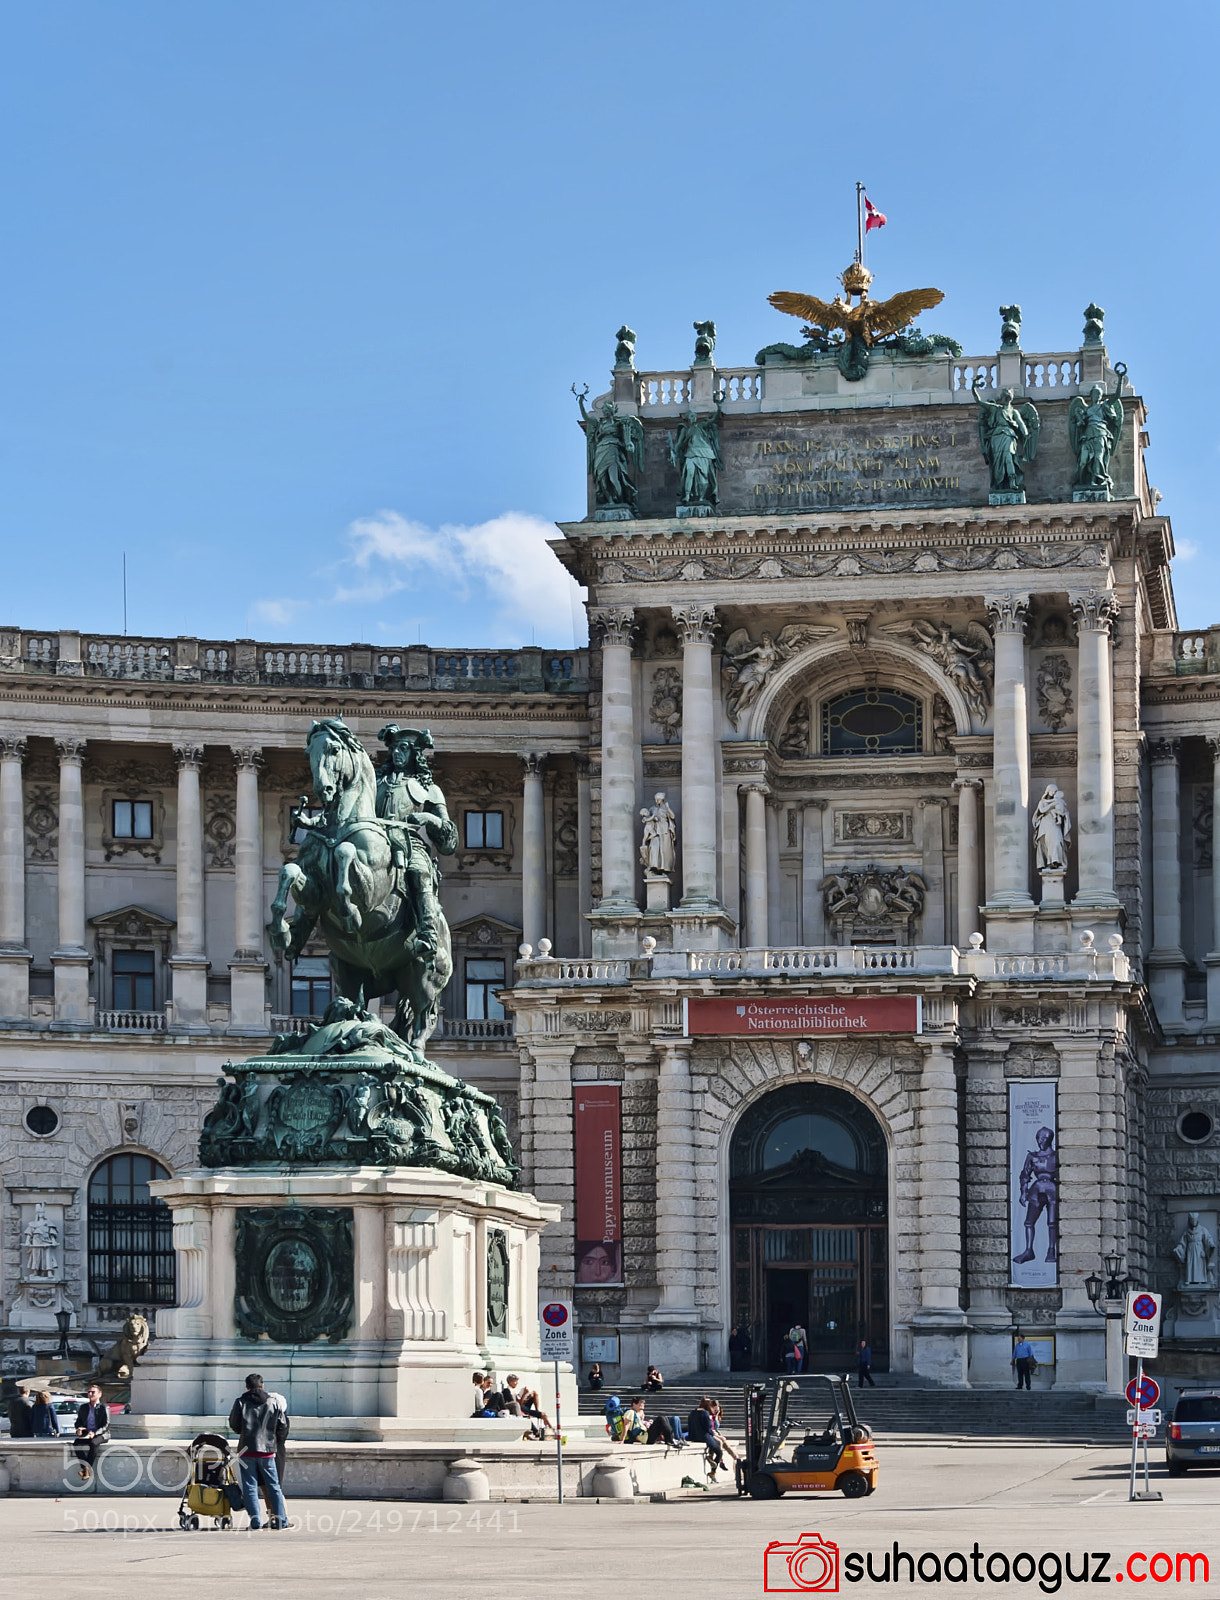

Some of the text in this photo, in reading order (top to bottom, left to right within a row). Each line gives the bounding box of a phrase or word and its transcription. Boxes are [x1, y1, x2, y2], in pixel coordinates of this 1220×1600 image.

[747, 1003, 846, 1015] Österreichische
[748, 1016, 868, 1029] Nationalbibliothek
[602, 1129, 617, 1244] Papyrusmuseum
[1132, 1320, 1154, 1332] Zone
[545, 1328, 567, 1339] Zone
